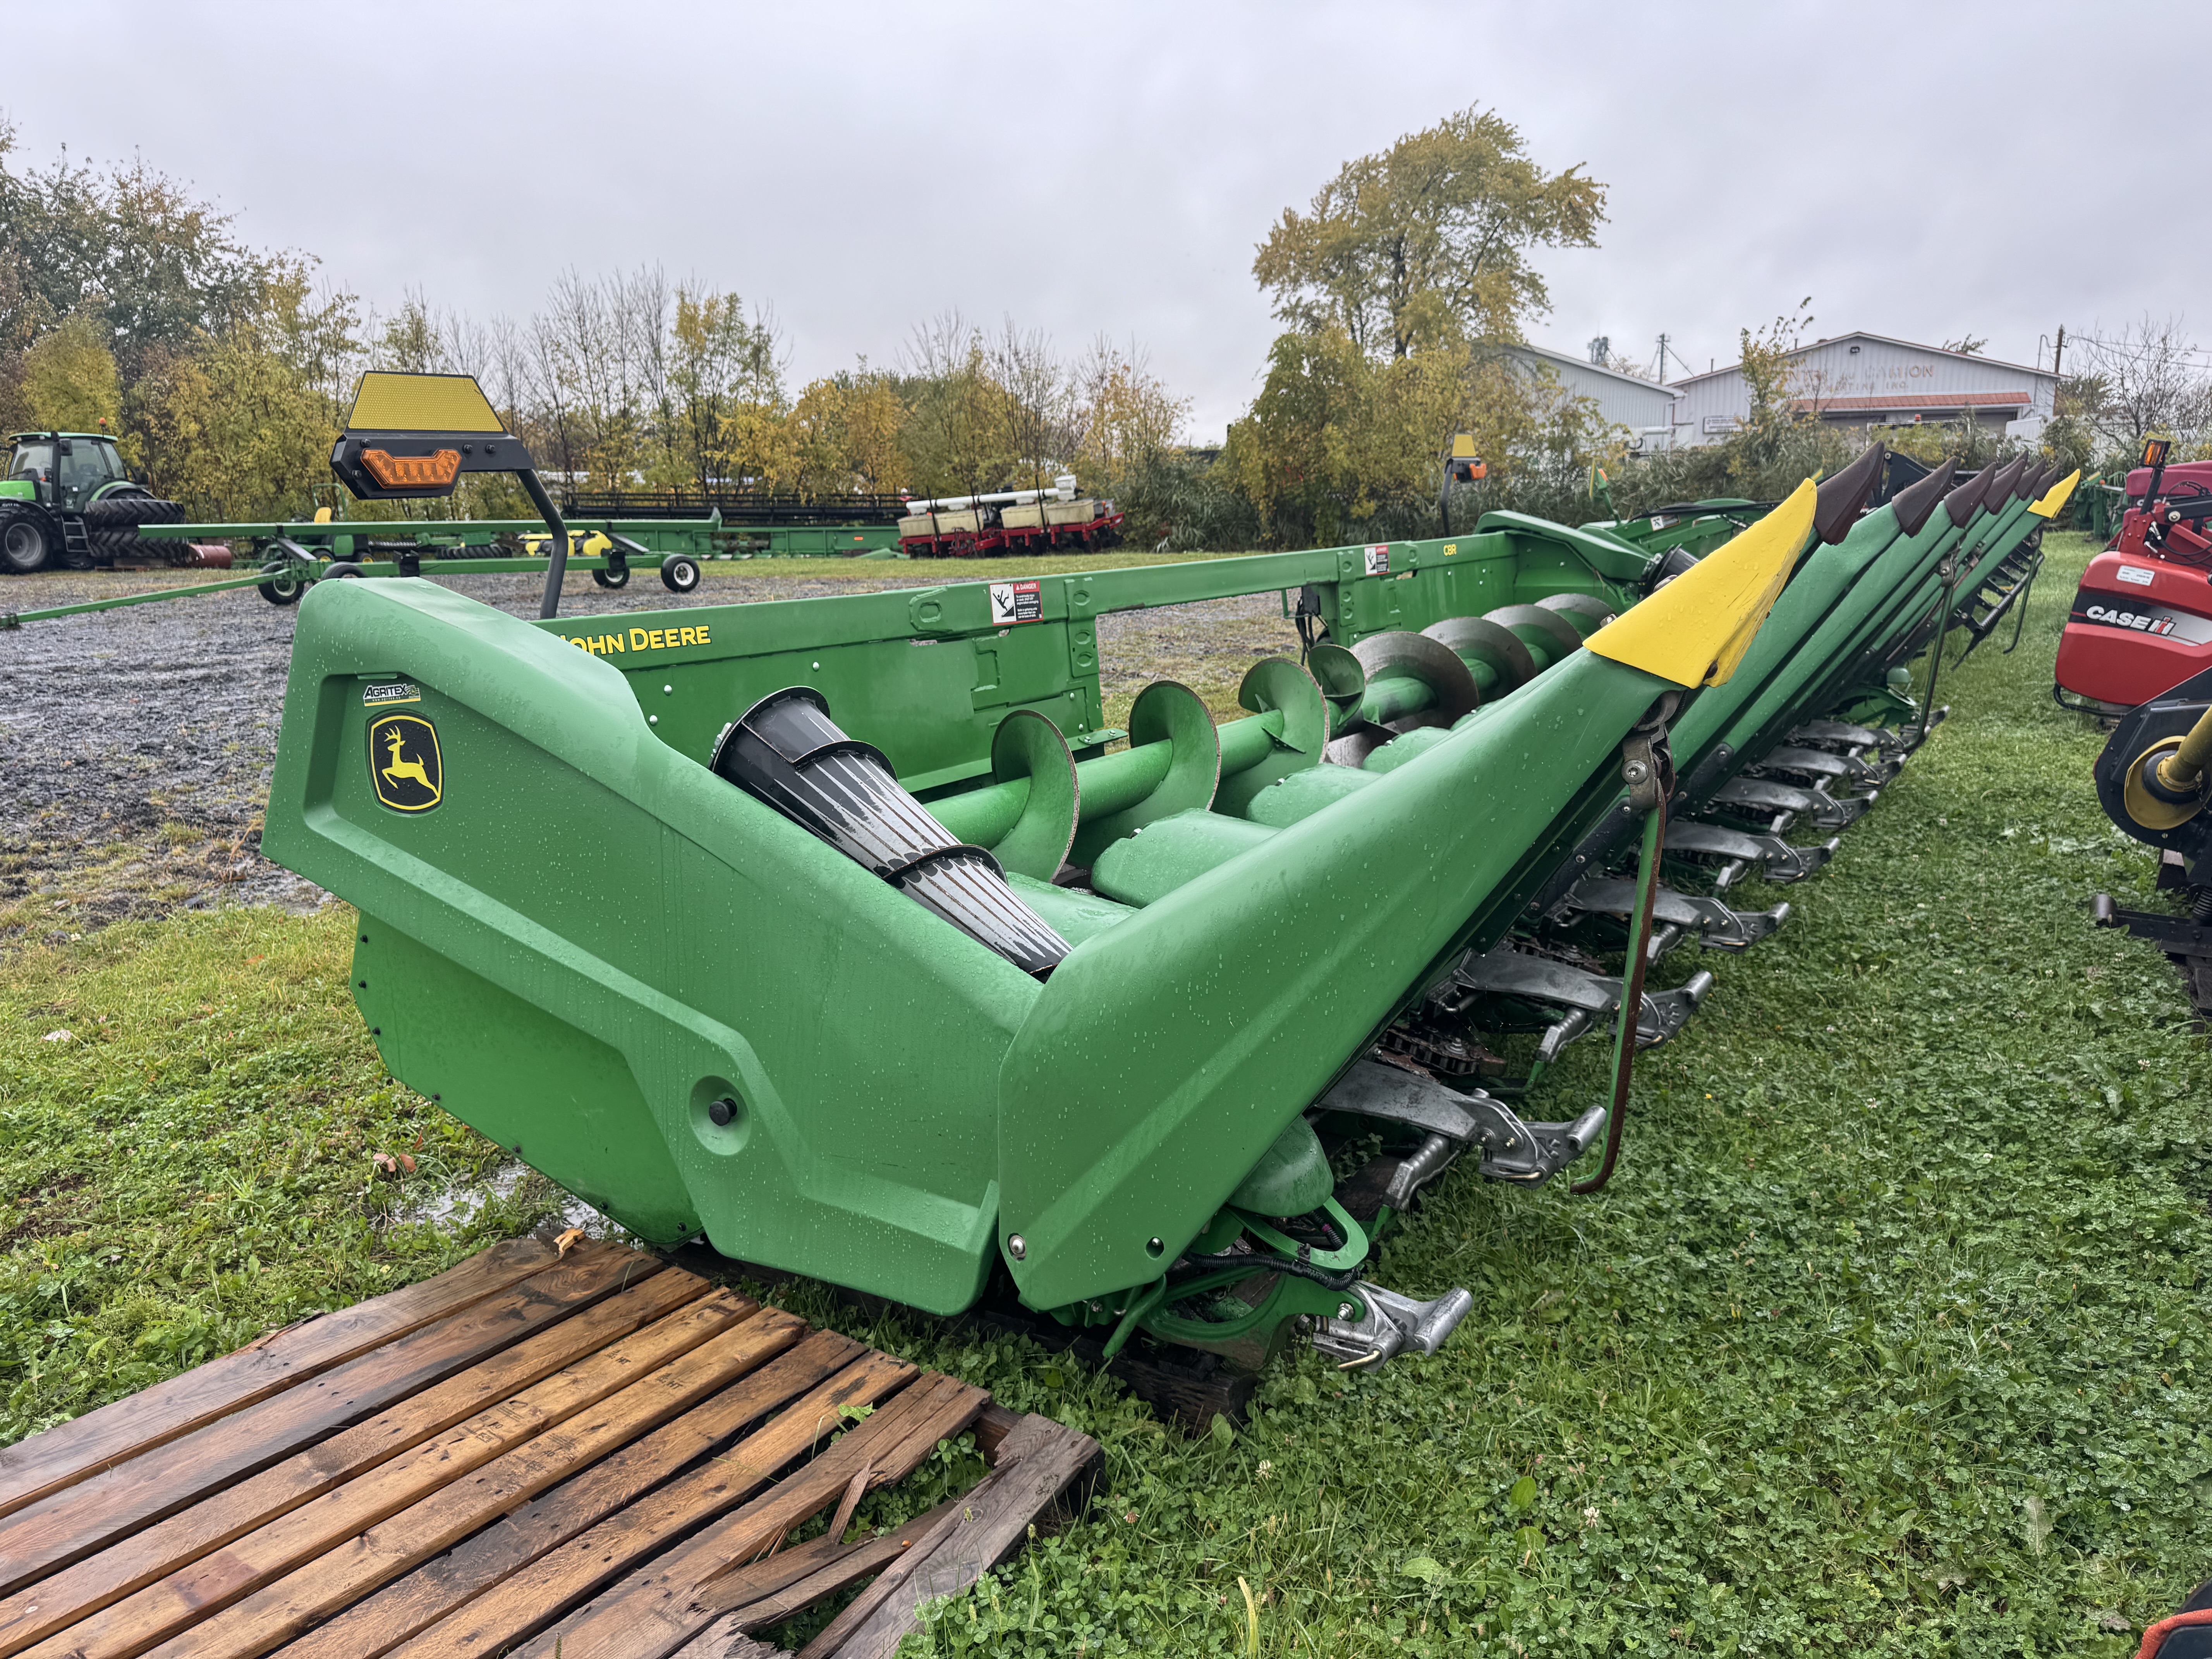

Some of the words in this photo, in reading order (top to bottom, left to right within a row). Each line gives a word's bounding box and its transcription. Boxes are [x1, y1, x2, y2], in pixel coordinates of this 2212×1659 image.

[1443, 544, 1457, 556] C8R
[2087, 605, 2152, 630] CASE
[560, 633, 625, 655] OHN
[629, 625, 711, 651] DEERE
[364, 685, 407, 698] AGRITEX
[666, 1380, 683, 1389] HT
